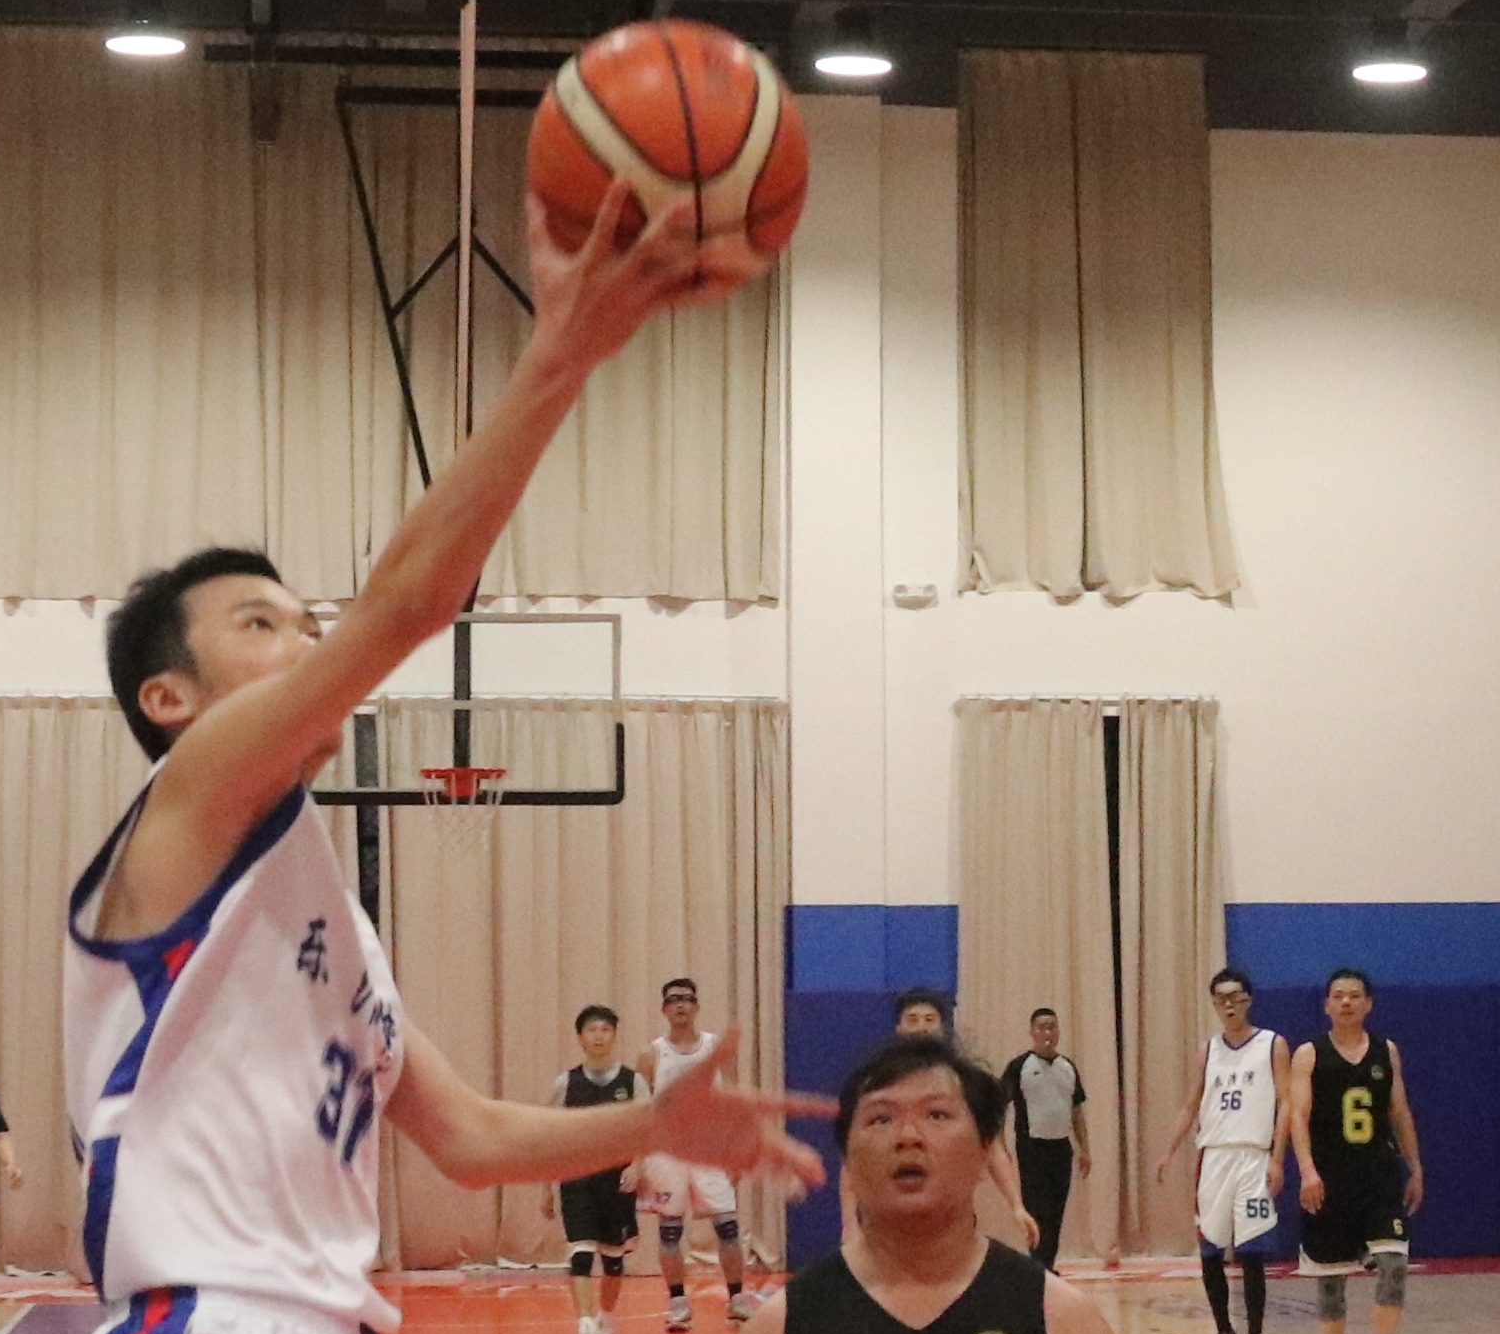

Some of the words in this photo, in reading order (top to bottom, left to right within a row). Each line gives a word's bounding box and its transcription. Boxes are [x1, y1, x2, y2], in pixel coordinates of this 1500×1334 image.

[1220, 1090, 1242, 1111] 56
[1342, 1086, 1374, 1144] 6
[1246, 1198, 1270, 1219] 56
